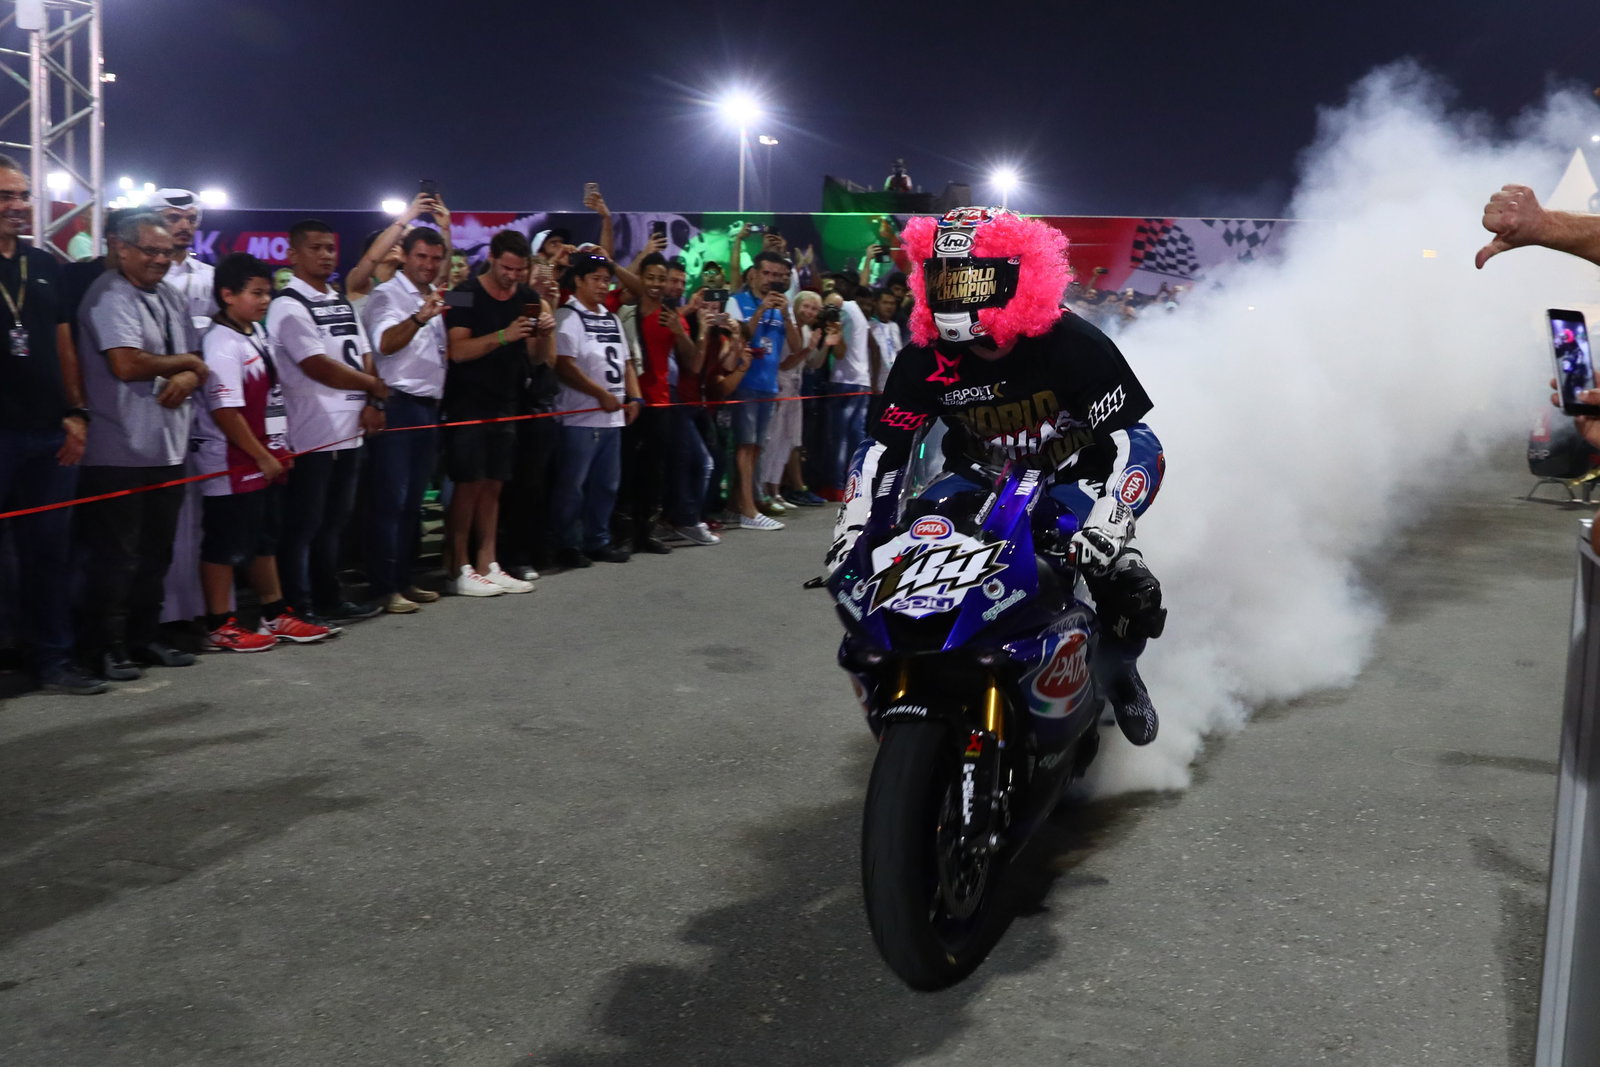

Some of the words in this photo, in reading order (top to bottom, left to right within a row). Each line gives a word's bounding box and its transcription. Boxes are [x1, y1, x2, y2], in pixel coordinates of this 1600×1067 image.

[942, 235, 970, 248] Arai
[948, 268, 996, 285] WORLD
[939, 281, 997, 299] CHAMPION
[962, 296, 990, 304] 2017
[605, 346, 621, 384] S
[966, 390, 1061, 437] ORLD
[1088, 384, 1126, 430] 144
[1014, 469, 1041, 496] YAMAHA
[1122, 475, 1144, 501] PATA
[916, 523, 945, 535] PATA
[867, 540, 1010, 616] 144
[1044, 653, 1086, 687] PATA
[882, 705, 929, 718] YAMAHA
